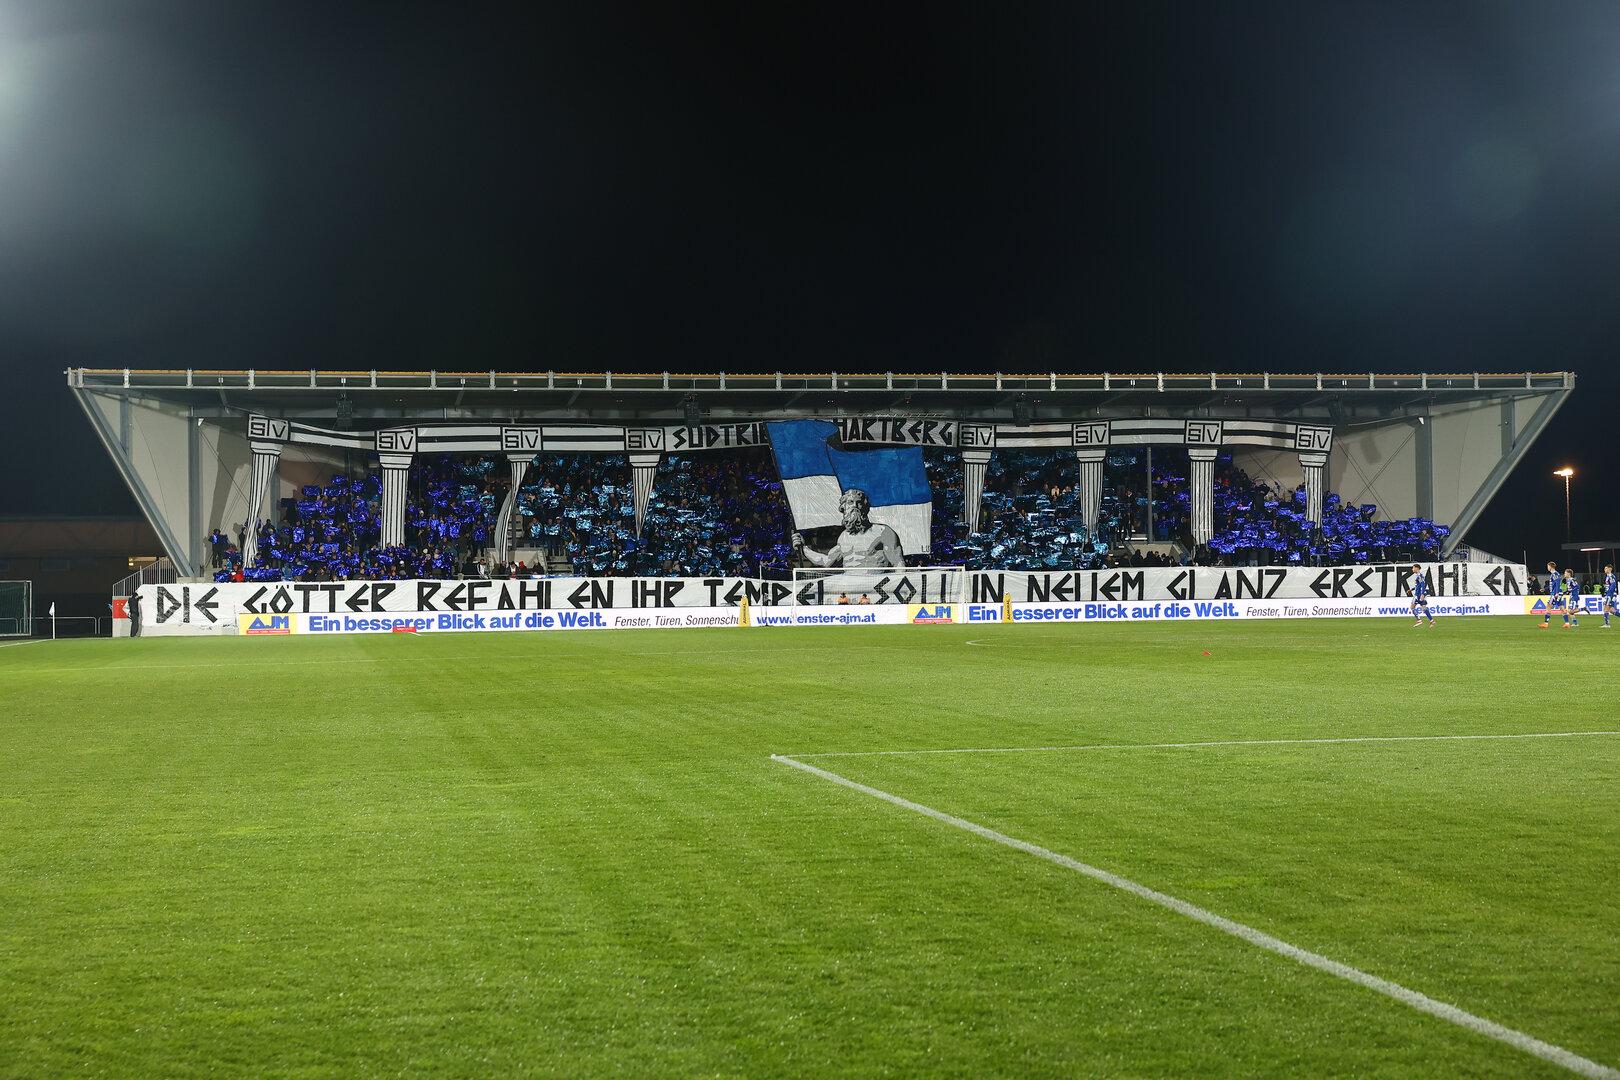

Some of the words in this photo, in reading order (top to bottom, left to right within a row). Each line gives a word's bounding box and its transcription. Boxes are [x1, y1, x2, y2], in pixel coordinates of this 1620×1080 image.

[250, 417, 286, 439] STV
[504, 428, 539, 449] STV
[628, 428, 661, 449] STV
[833, 417, 953, 445] HARTBERG
[961, 425, 993, 446] STV
[1075, 423, 1107, 444] STV
[1188, 422, 1219, 443] STV
[1297, 426, 1330, 449] STV
[379, 430, 414, 450] STV
[156, 586, 219, 623] DIE
[243, 583, 396, 613] GÖTTER
[631, 579, 685, 608] IHR
[972, 574, 1004, 603] IN
[309, 616, 341, 631] Ein
[344, 615, 435, 631] besserer
[438, 613, 486, 630] Blick
[489, 612, 522, 629] auf
[525, 612, 554, 628] die
[558, 611, 607, 627] Welt.
[615, 615, 651, 627] Fenster,
[655, 615, 683, 627] Türen,
[757, 613, 876, 625] www.enster-ajm.at
[915, 605, 951, 619] AJM
[968, 605, 997, 620] Ein
[1001, 605, 1081, 620] esserer
[1084, 603, 1128, 619] Blick
[1131, 603, 1161, 619] auf
[1164, 603, 1191, 618] die
[1194, 602, 1239, 618] Welt.
[1246, 606, 1280, 618] Fenster,
[1283, 606, 1310, 617] Türen,
[1311, 605, 1372, 616] Sonnenschutz
[248, 615, 290, 629] AJM
